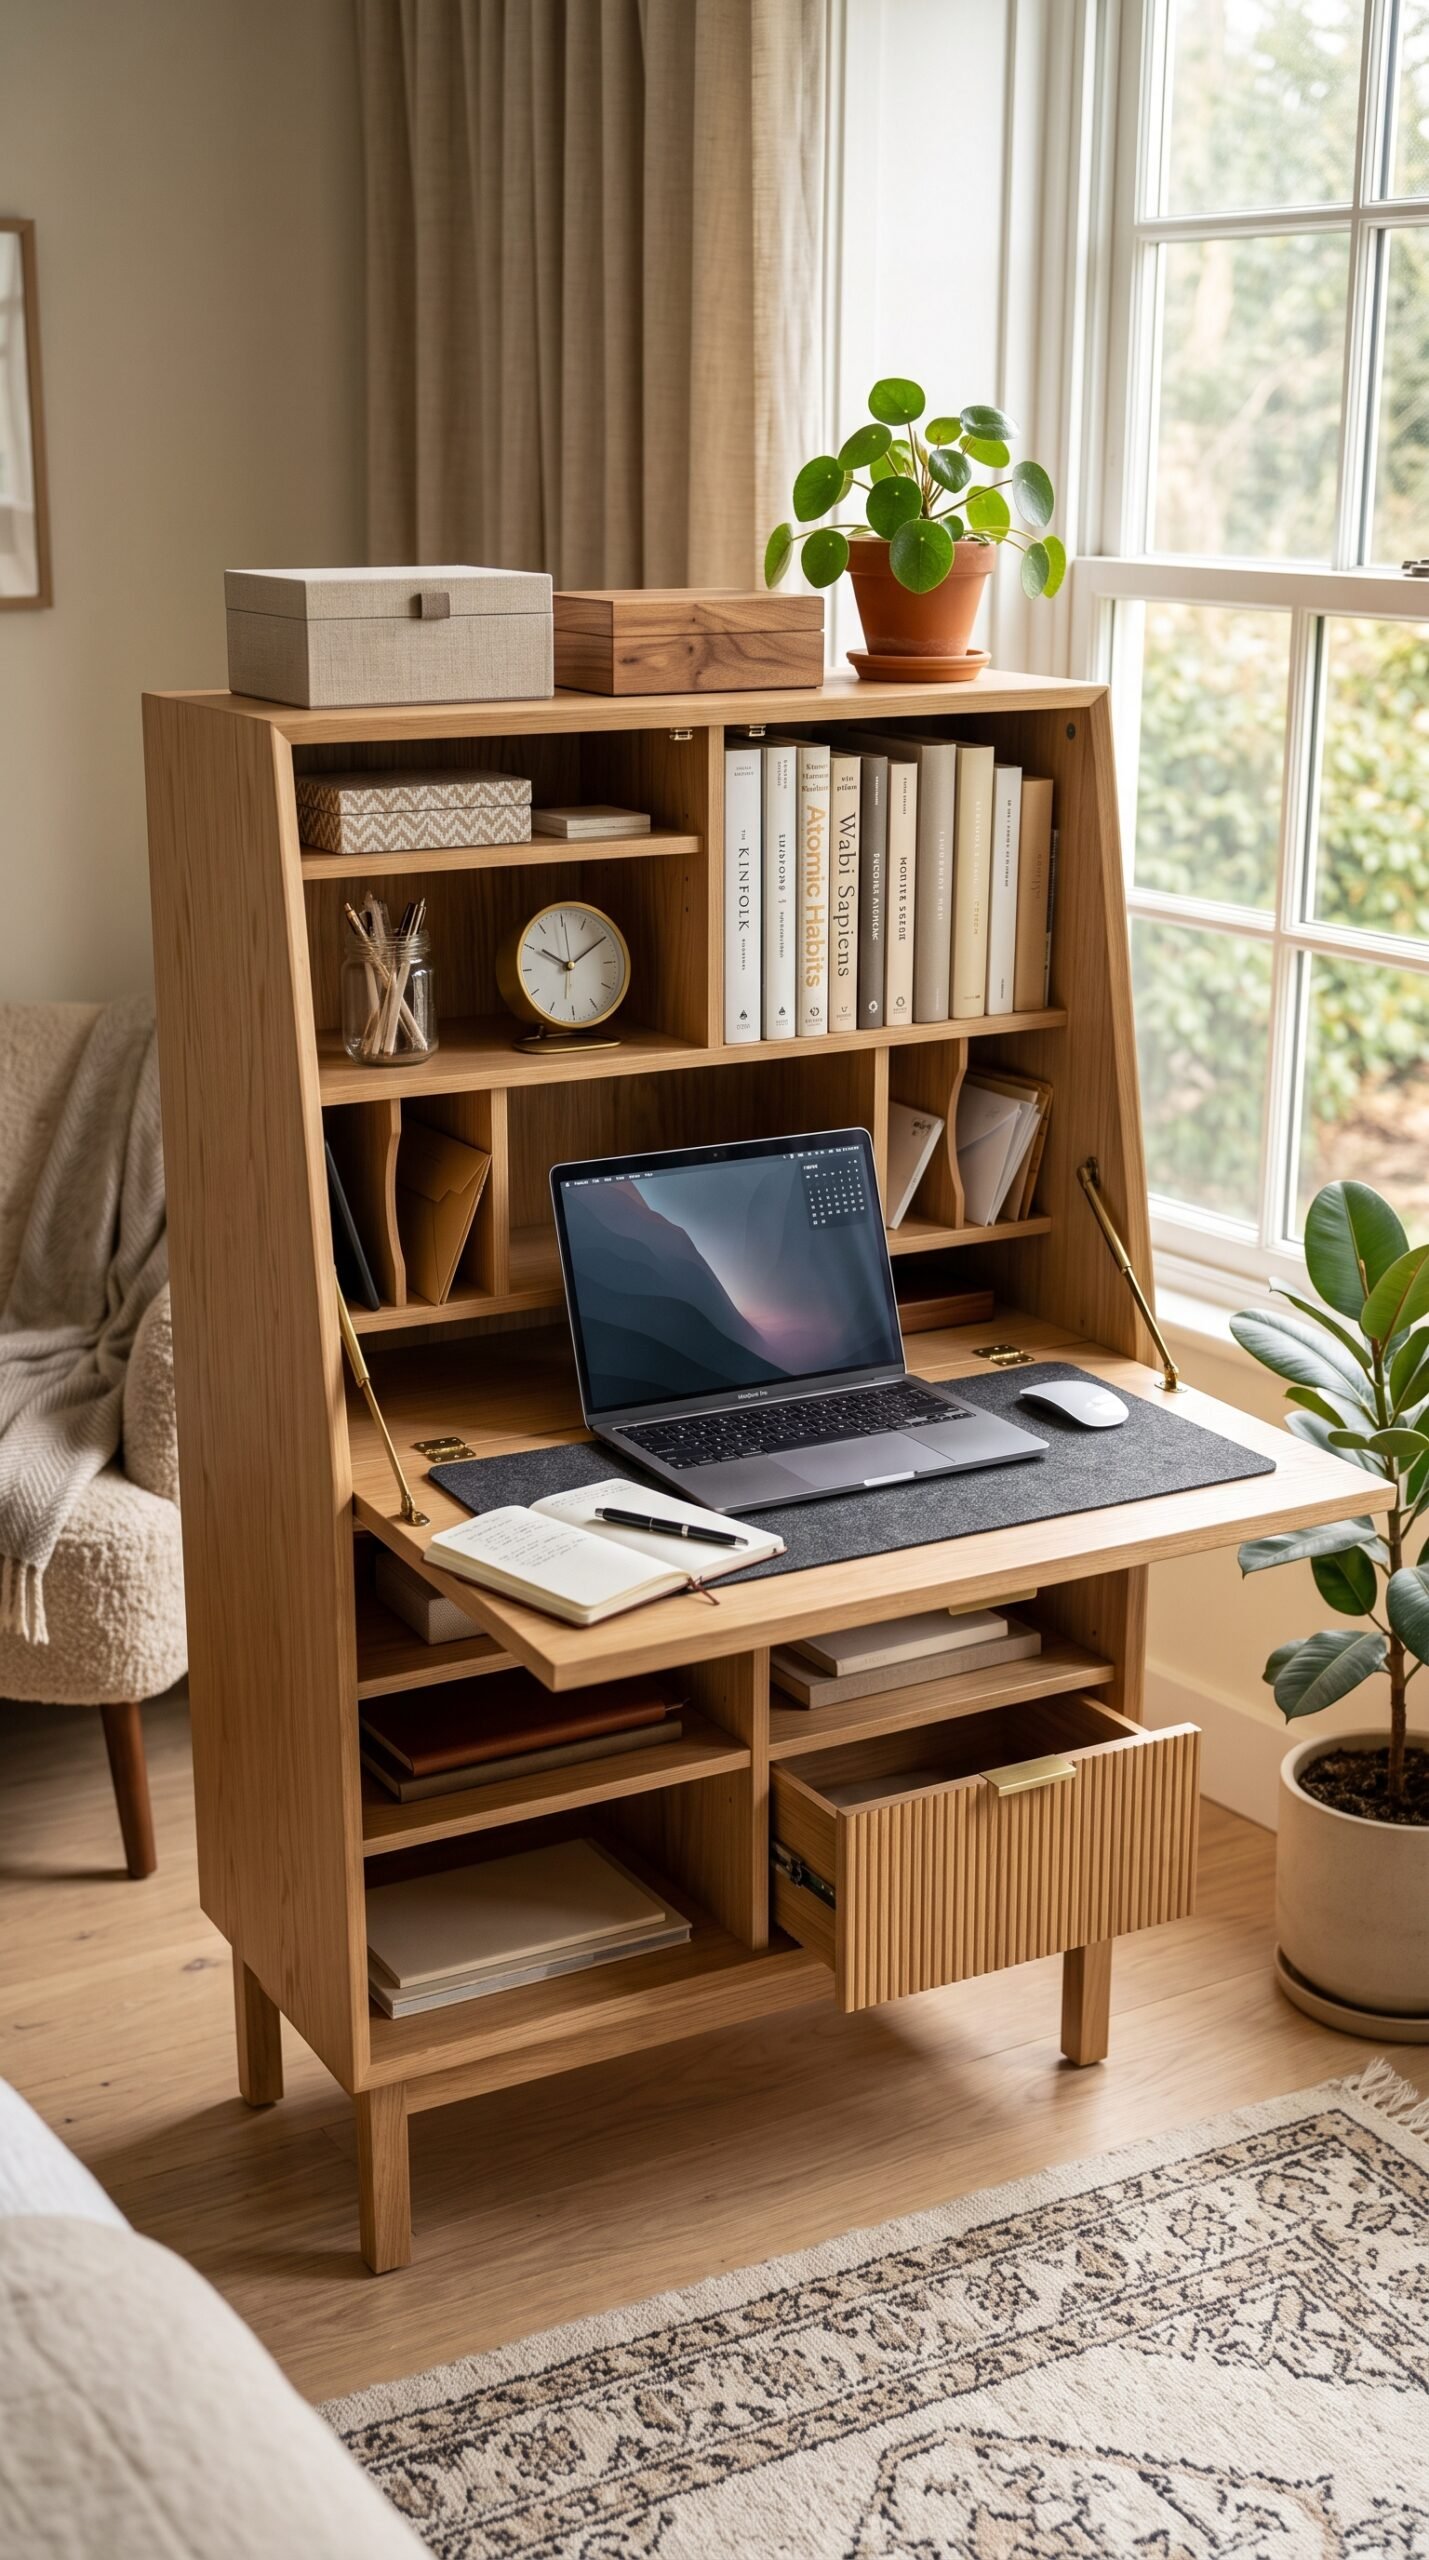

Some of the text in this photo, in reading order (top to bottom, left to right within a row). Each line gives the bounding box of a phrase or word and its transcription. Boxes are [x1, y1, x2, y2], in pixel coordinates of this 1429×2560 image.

[738, 847, 750, 931] KINFOLK
[805, 804, 827, 898] Atomic
[832, 811, 857, 978] Wabi Sapiens
[804, 903, 826, 988] Habits
